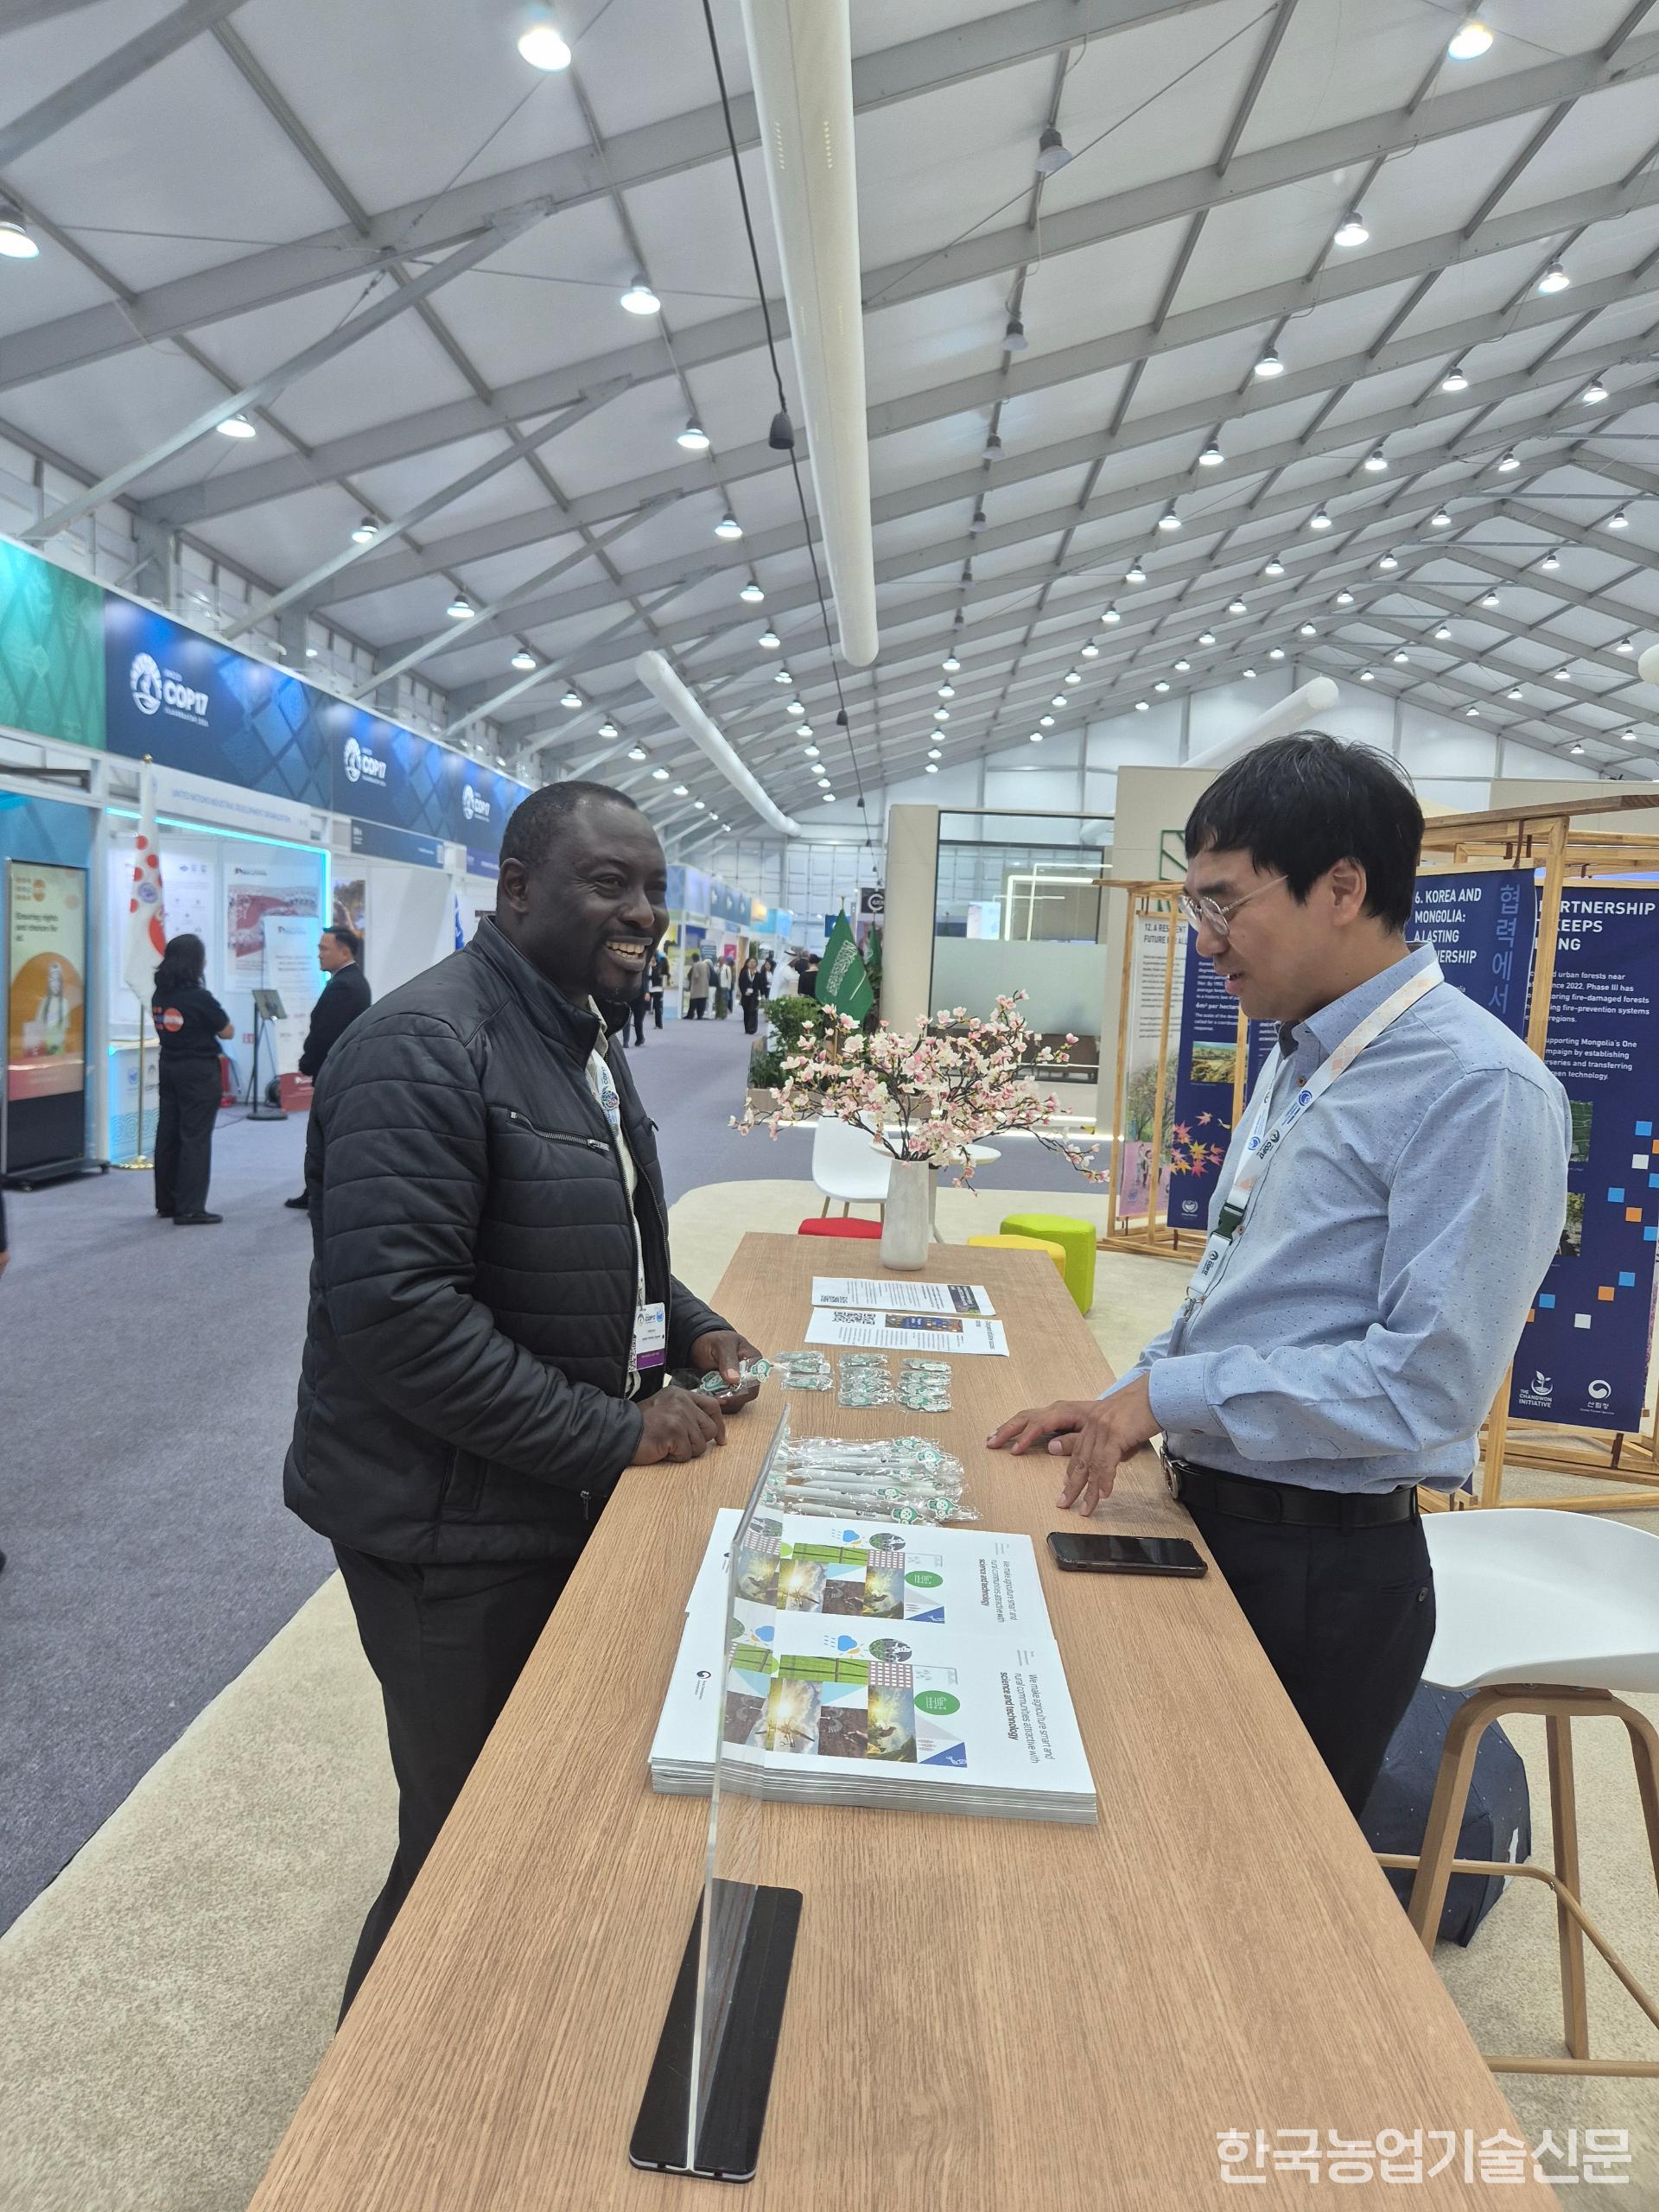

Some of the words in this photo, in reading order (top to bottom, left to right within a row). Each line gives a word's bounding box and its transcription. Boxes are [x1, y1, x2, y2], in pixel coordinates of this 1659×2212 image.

[162, 679, 209, 716] COP17
[361, 753, 387, 779] COP17
[1414, 891, 1423, 904] 6.
[1425, 889, 1456, 904] KOREA
[1458, 888, 1482, 902] AND
[1539, 900, 1656, 915] RTNERSHIP
[1414, 909, 1466, 924] MONGOLIA:
[1144, 935, 1166, 944] FUTURE
[1414, 930, 1420, 942] A
[1423, 930, 1460, 944] LASTING
[1488, 884, 1521, 1014] 협력에서
[1438, 950, 1477, 963] ERSHIP
[1581, 971, 1606, 980] forests
[1572, 994, 1622, 1003] fire-damaged
[1624, 995, 1649, 1004] forests
[1562, 1004, 1617, 1013] fire-prevention
[1574, 1048, 1583, 1057] by
[1585, 1050, 1630, 1059] establishing
[1588, 1060, 1633, 1071] transferring
[1568, 1071, 1608, 1080] technology.
[1258, 1141, 1272, 1160] COP17
[1519, 1394, 1553, 1402] CHANGWON
[1519, 1399, 1551, 1408] INITIATIVE
[979, 1559, 988, 1575] science
[982, 1582, 990, 1606] technology
[1009, 1612, 1018, 1621] and
[1000, 1671, 1011, 1694] science
[1014, 1673, 1027, 1686] rural
[1028, 1674, 1038, 1683] We
[1030, 1684, 1039, 1699] make
[1004, 1694, 1015, 1706] and
[1016, 1686, 1032, 1722] communities
[1032, 1699, 1047, 1730] agriculture
[1006, 1706, 1020, 1741] technology
[1023, 1722, 1036, 1750] attractive
[1039, 1730, 1052, 1747] smart
[1030, 1750, 1040, 1764] with
[1043, 1747, 1055, 1760] and
